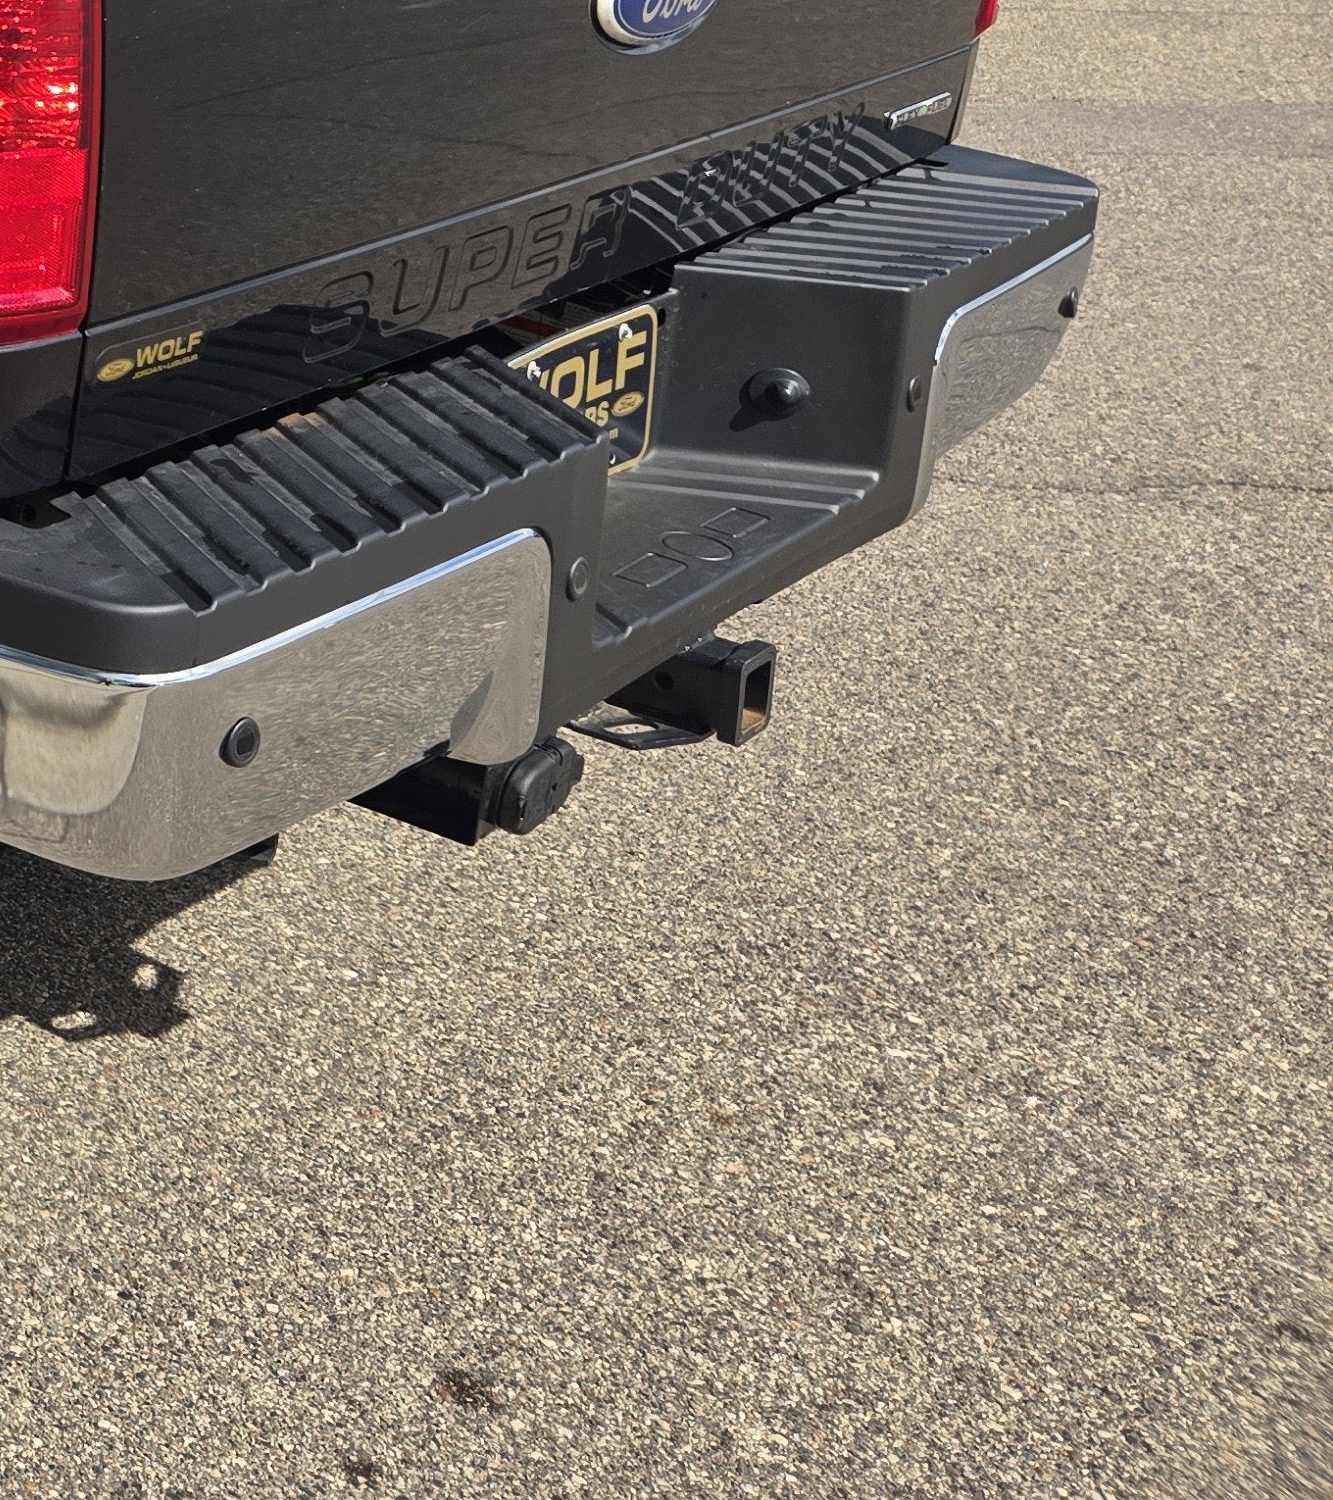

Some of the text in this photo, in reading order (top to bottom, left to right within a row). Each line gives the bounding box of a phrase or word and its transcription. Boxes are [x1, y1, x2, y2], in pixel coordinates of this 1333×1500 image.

[301, 101, 867, 364] SUPER DUTY
[136, 330, 204, 368] WOLF
[539, 330, 647, 409] OLF
